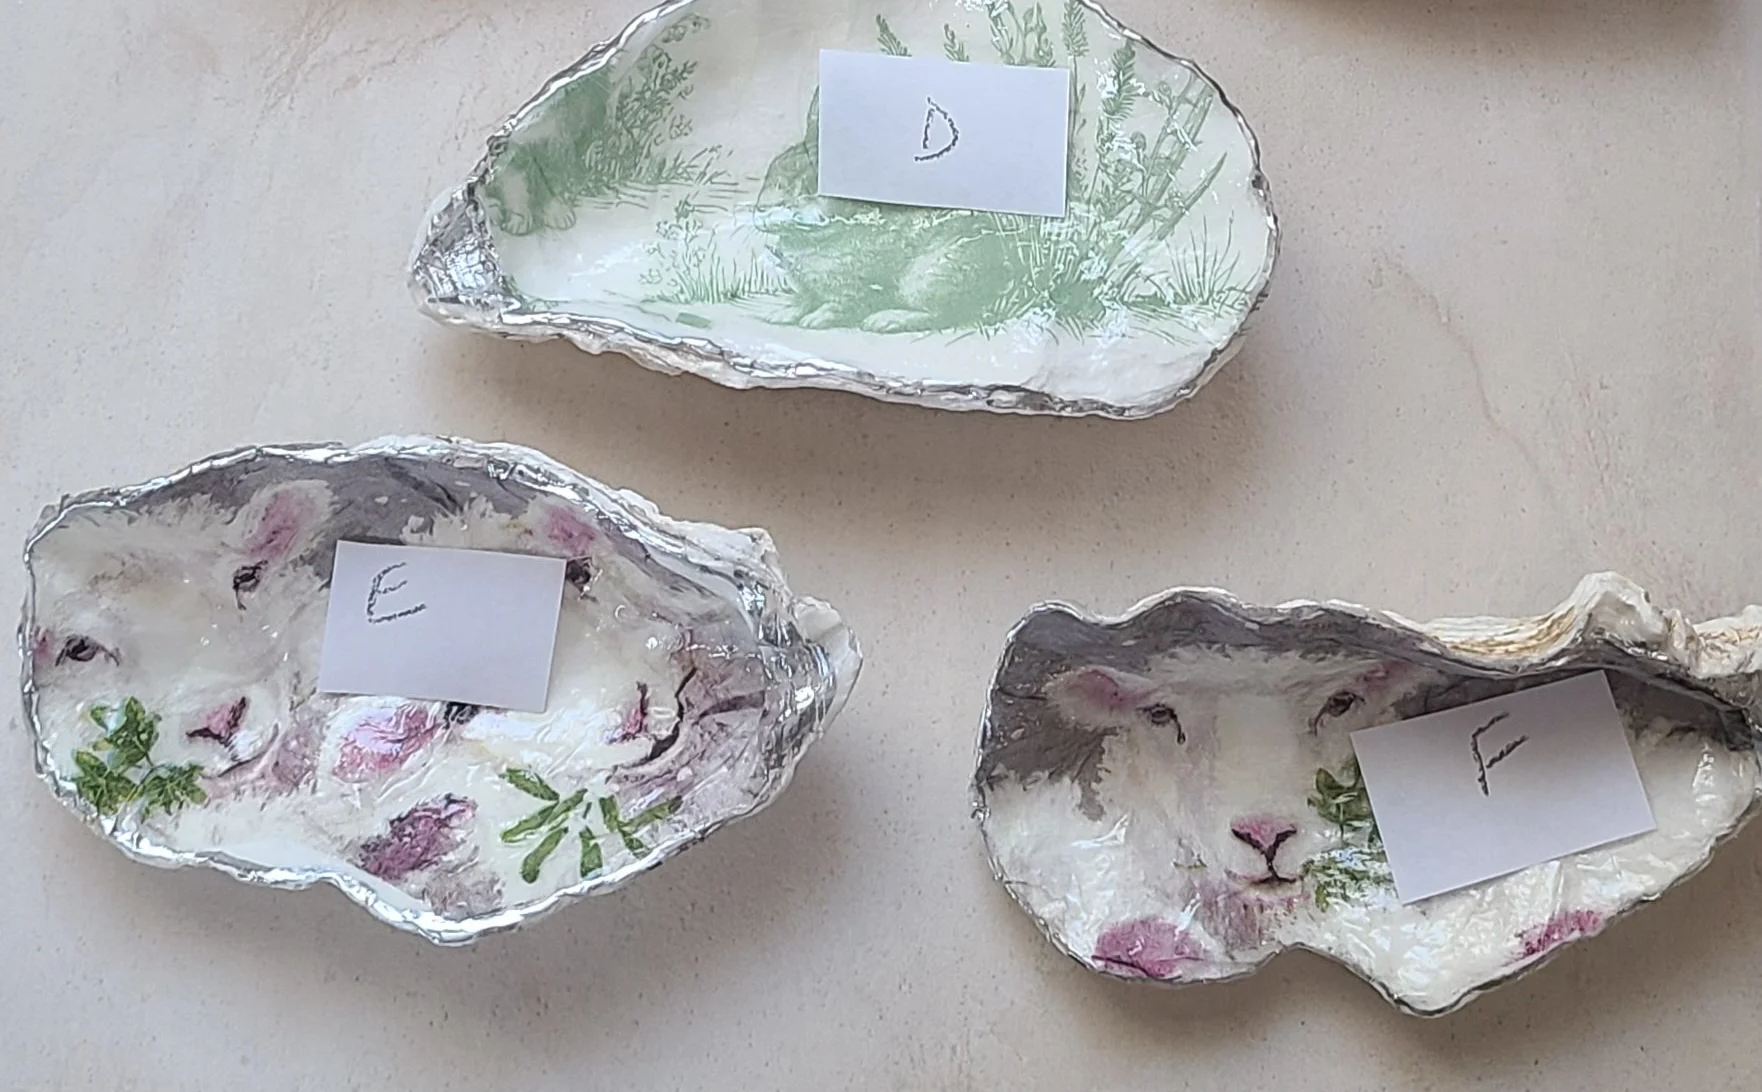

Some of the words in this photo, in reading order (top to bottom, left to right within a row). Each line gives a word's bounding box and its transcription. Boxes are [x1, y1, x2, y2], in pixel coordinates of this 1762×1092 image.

[913, 96, 960, 162] D
[367, 561, 427, 624] E
[1471, 712, 1528, 797] F
